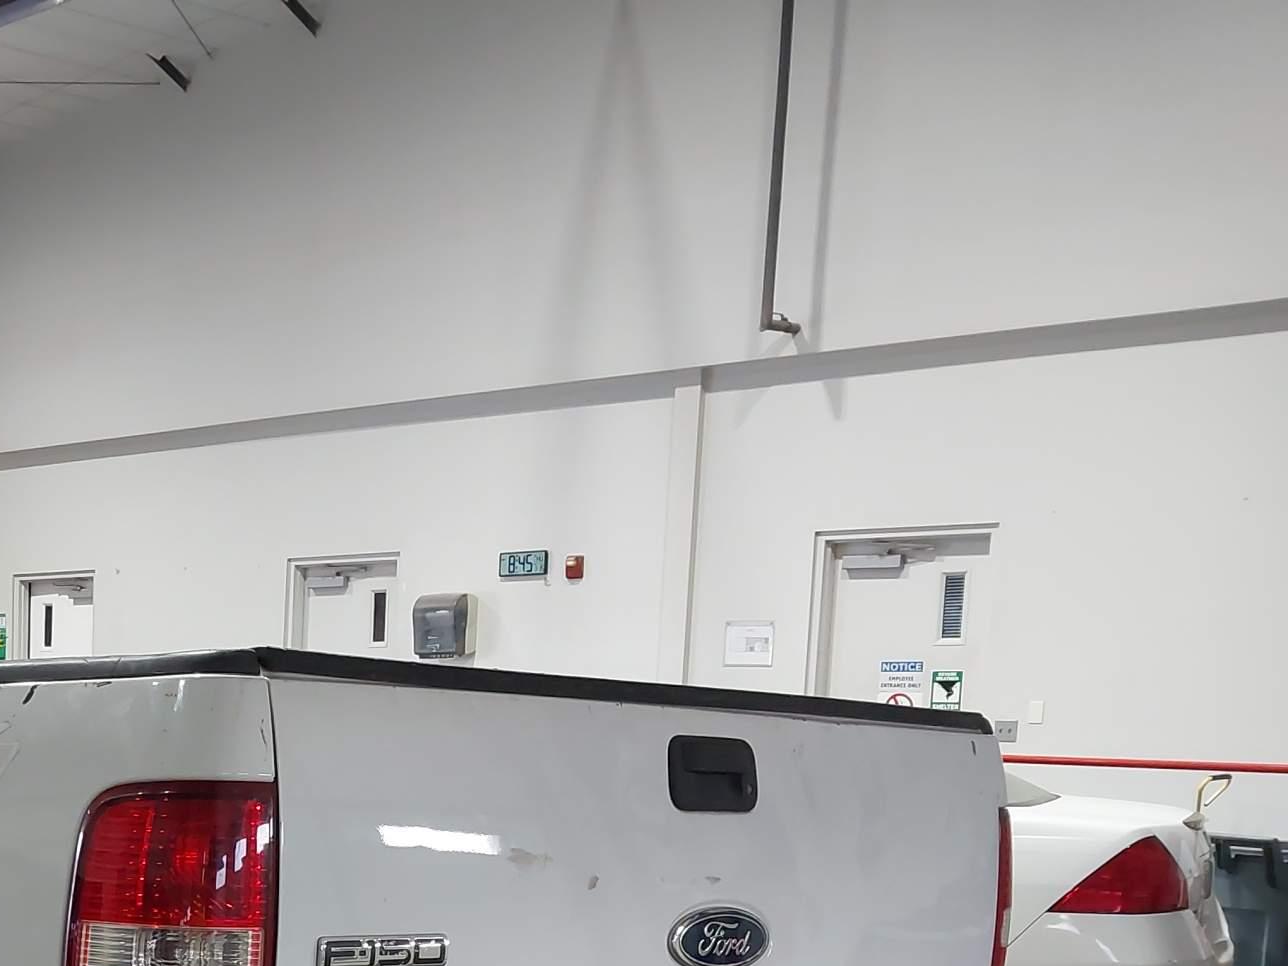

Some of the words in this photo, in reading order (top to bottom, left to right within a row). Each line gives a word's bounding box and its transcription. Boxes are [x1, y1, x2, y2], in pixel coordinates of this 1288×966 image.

[508, 553, 533, 573] 8:45
[882, 662, 922, 672] NOTICE
[698, 921, 751, 957] Ford
